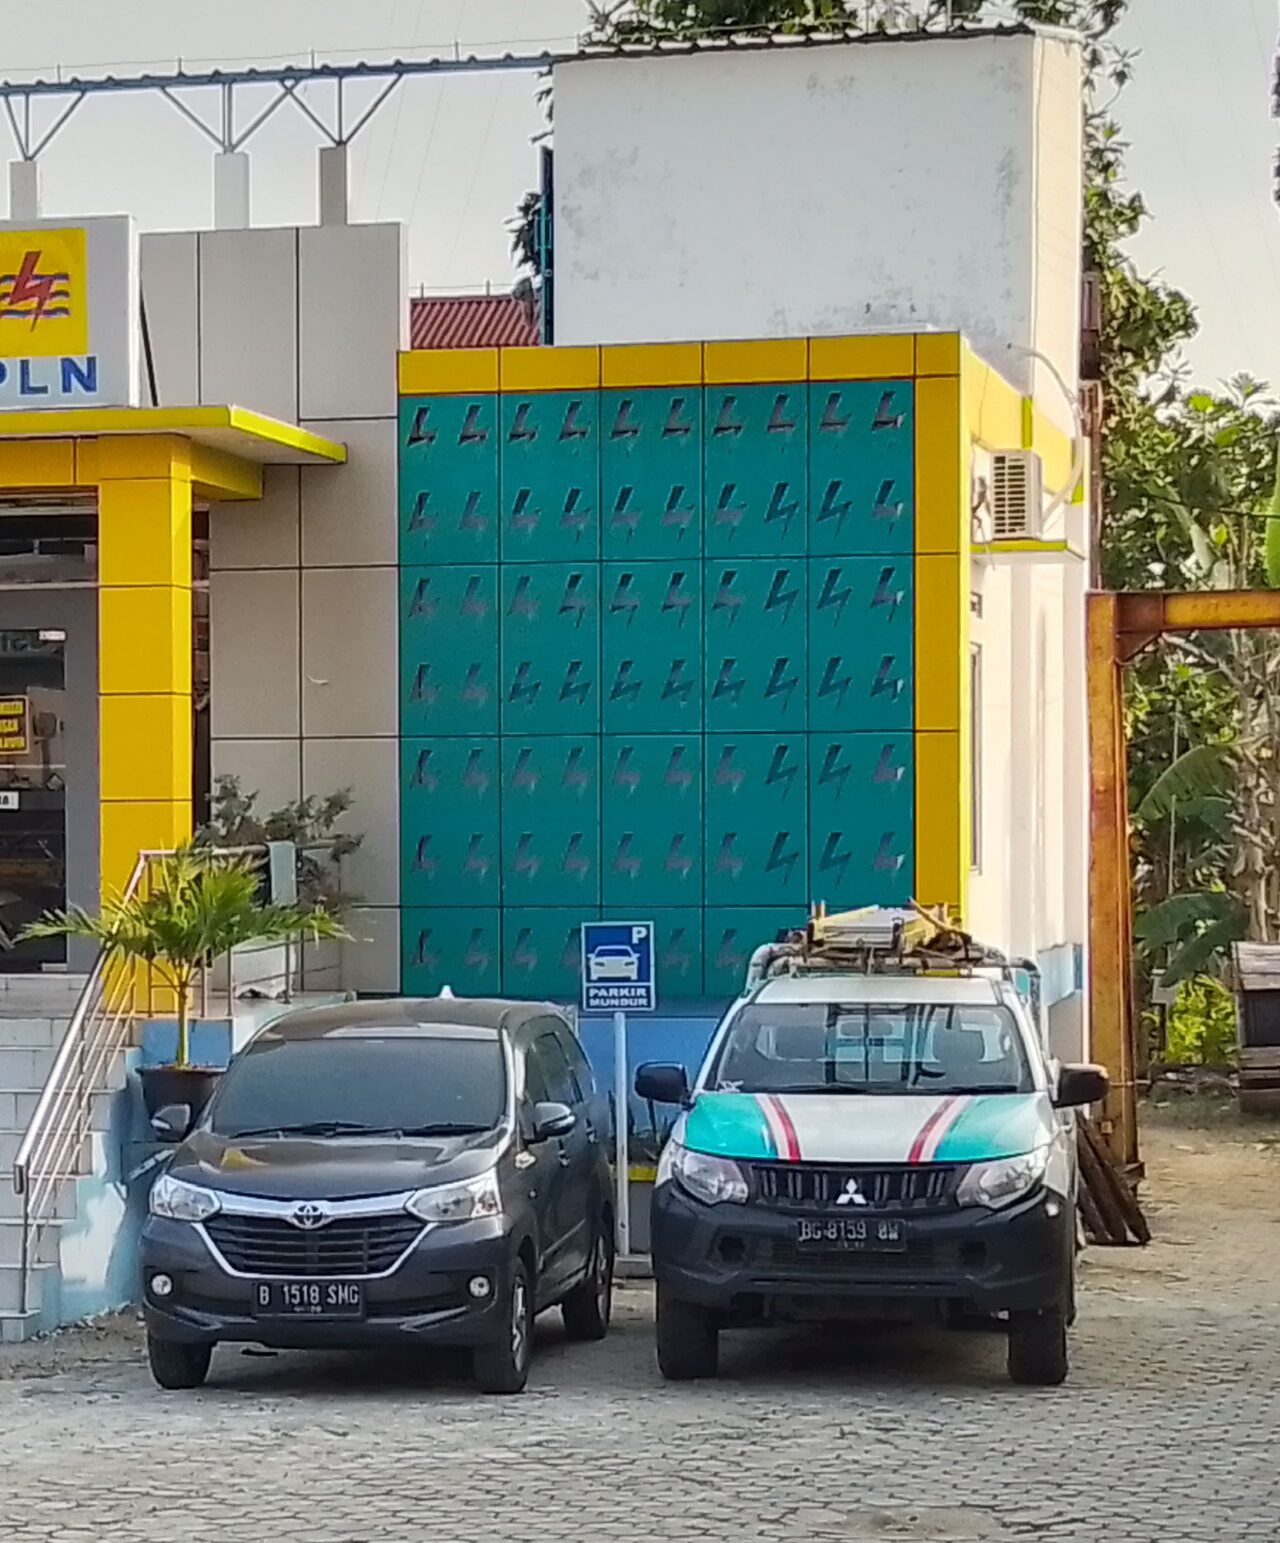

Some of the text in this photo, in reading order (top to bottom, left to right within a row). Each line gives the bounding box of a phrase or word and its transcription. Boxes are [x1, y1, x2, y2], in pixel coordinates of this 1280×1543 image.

[632, 926, 648, 944] P
[588, 987, 647, 997] PARKIR
[589, 998, 648, 1007] MUNDUR
[259, 1284, 359, 1305] B 1518 SMG
